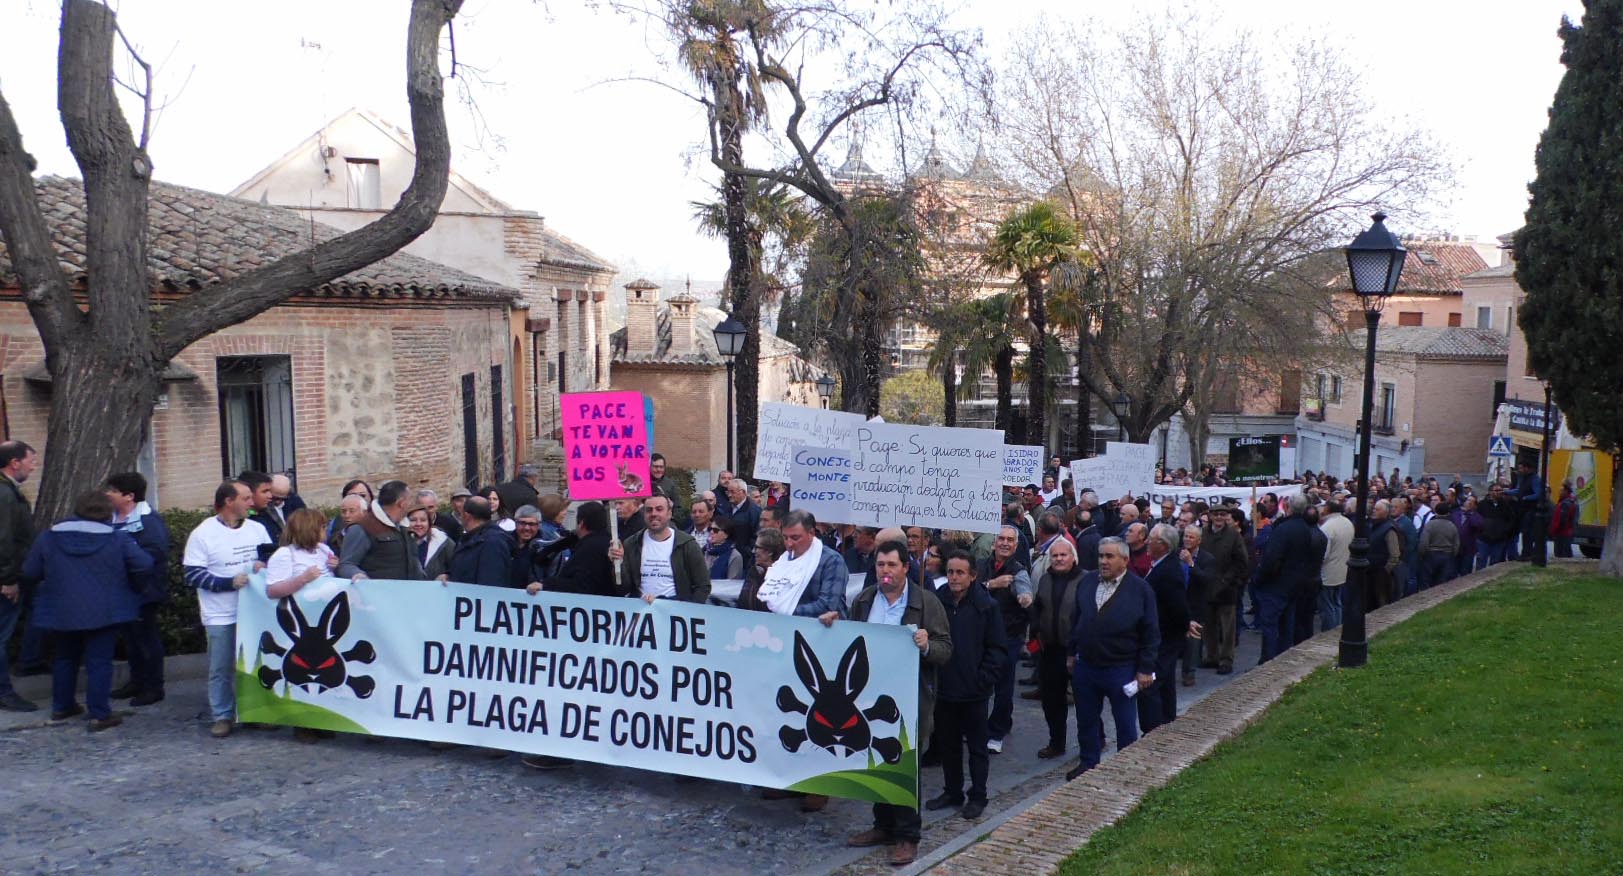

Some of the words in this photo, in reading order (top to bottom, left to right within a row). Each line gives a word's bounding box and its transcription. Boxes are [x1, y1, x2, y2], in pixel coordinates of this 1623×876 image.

[570, 425, 591, 439] TE
[597, 425, 633, 439] VAN
[571, 445, 581, 459] A
[590, 444, 645, 459] VOTAR
[909, 434, 928, 455] Si
[974, 449, 996, 468] que
[1008, 449, 1039, 458] ISIDRO
[573, 466, 605, 481] LOS
[808, 472, 851, 482] MONTE
[793, 489, 846, 501] CONEJO
[969, 490, 976, 500] a
[454, 596, 658, 650] PLATAFORMA
[669, 615, 707, 655] DE
[423, 640, 659, 700] DAMNIFICADOS
[671, 665, 733, 709] POR
[394, 684, 435, 722] LA
[446, 689, 549, 735] PLAGA
[559, 702, 602, 742] DE
[610, 708, 758, 763] CONEJOS
